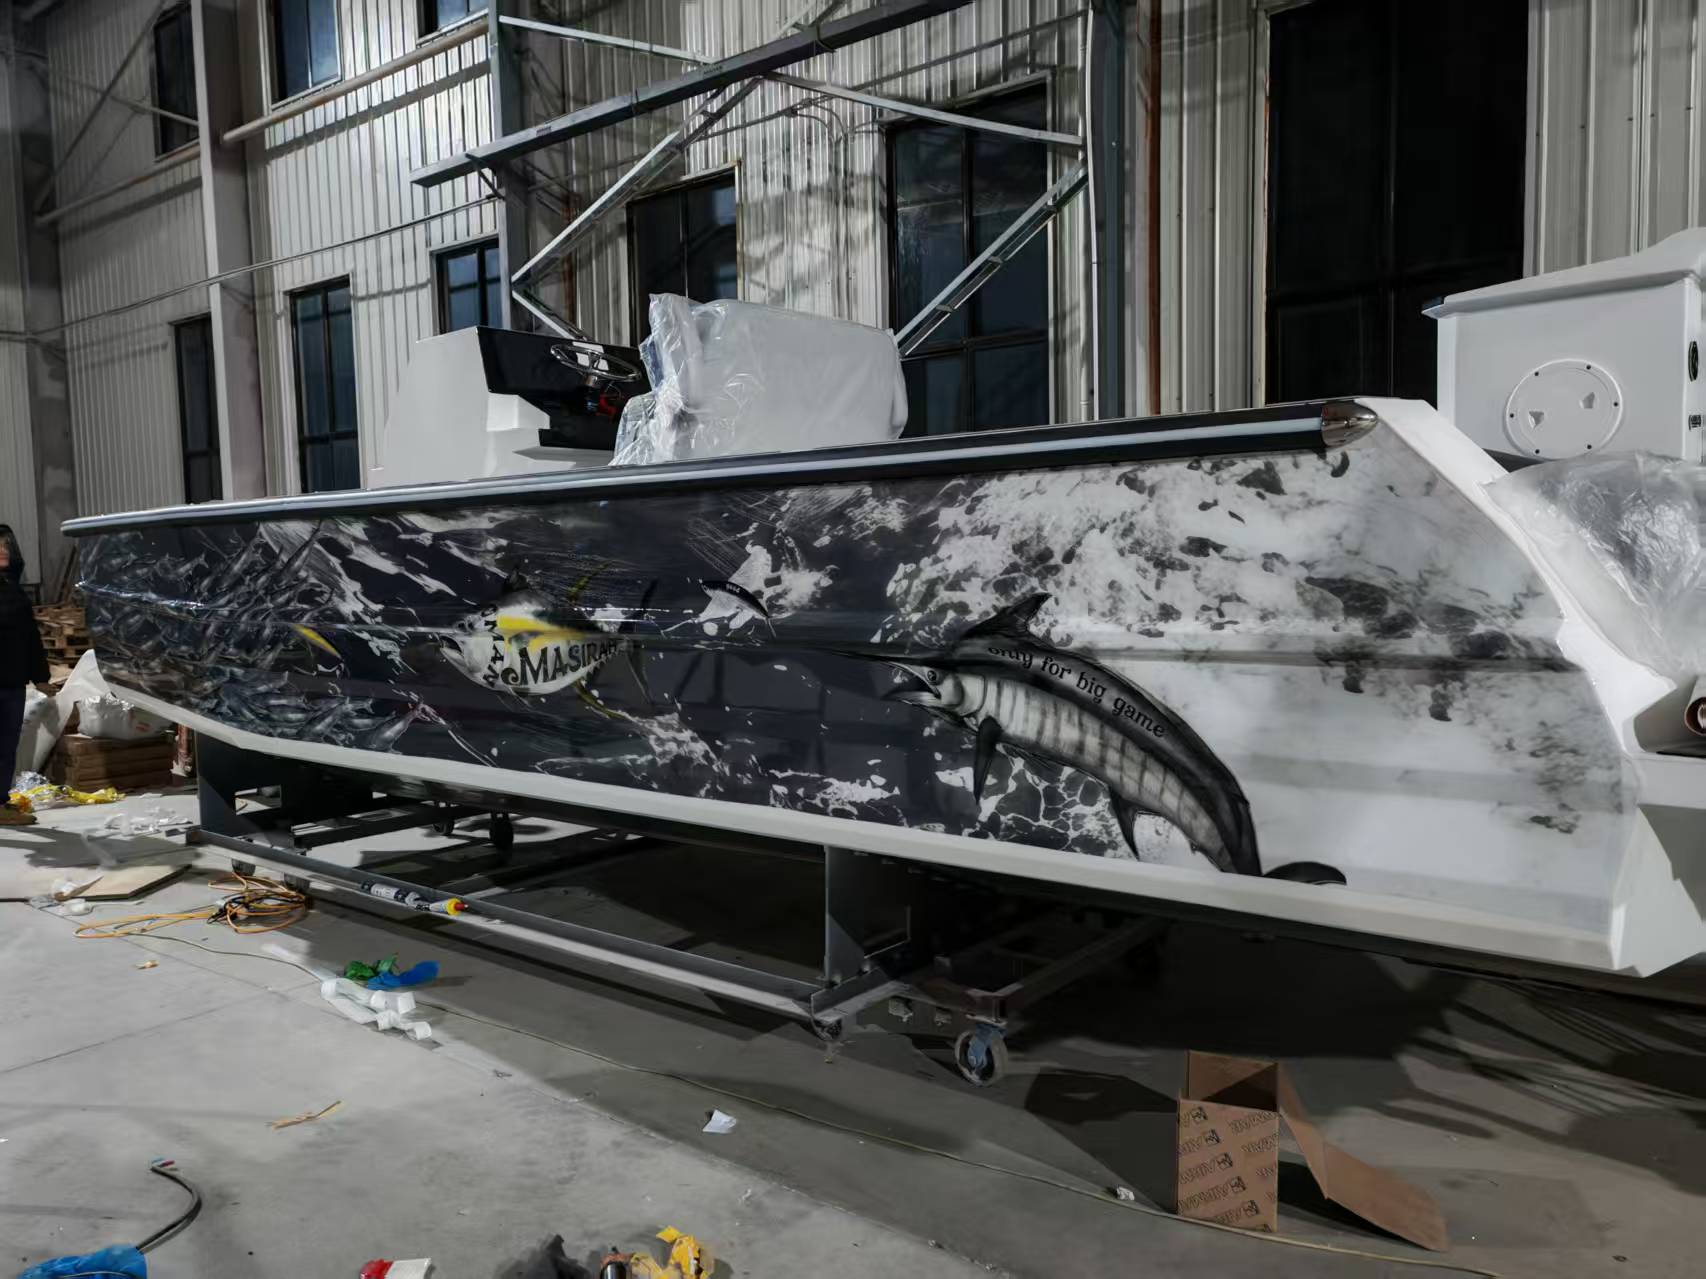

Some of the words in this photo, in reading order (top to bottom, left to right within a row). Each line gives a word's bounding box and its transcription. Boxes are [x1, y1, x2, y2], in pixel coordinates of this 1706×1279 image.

[501, 639, 617, 686] MASIRAH
[1040, 656, 1072, 680] for
[1076, 671, 1107, 703] big
[1112, 695, 1168, 738] game
